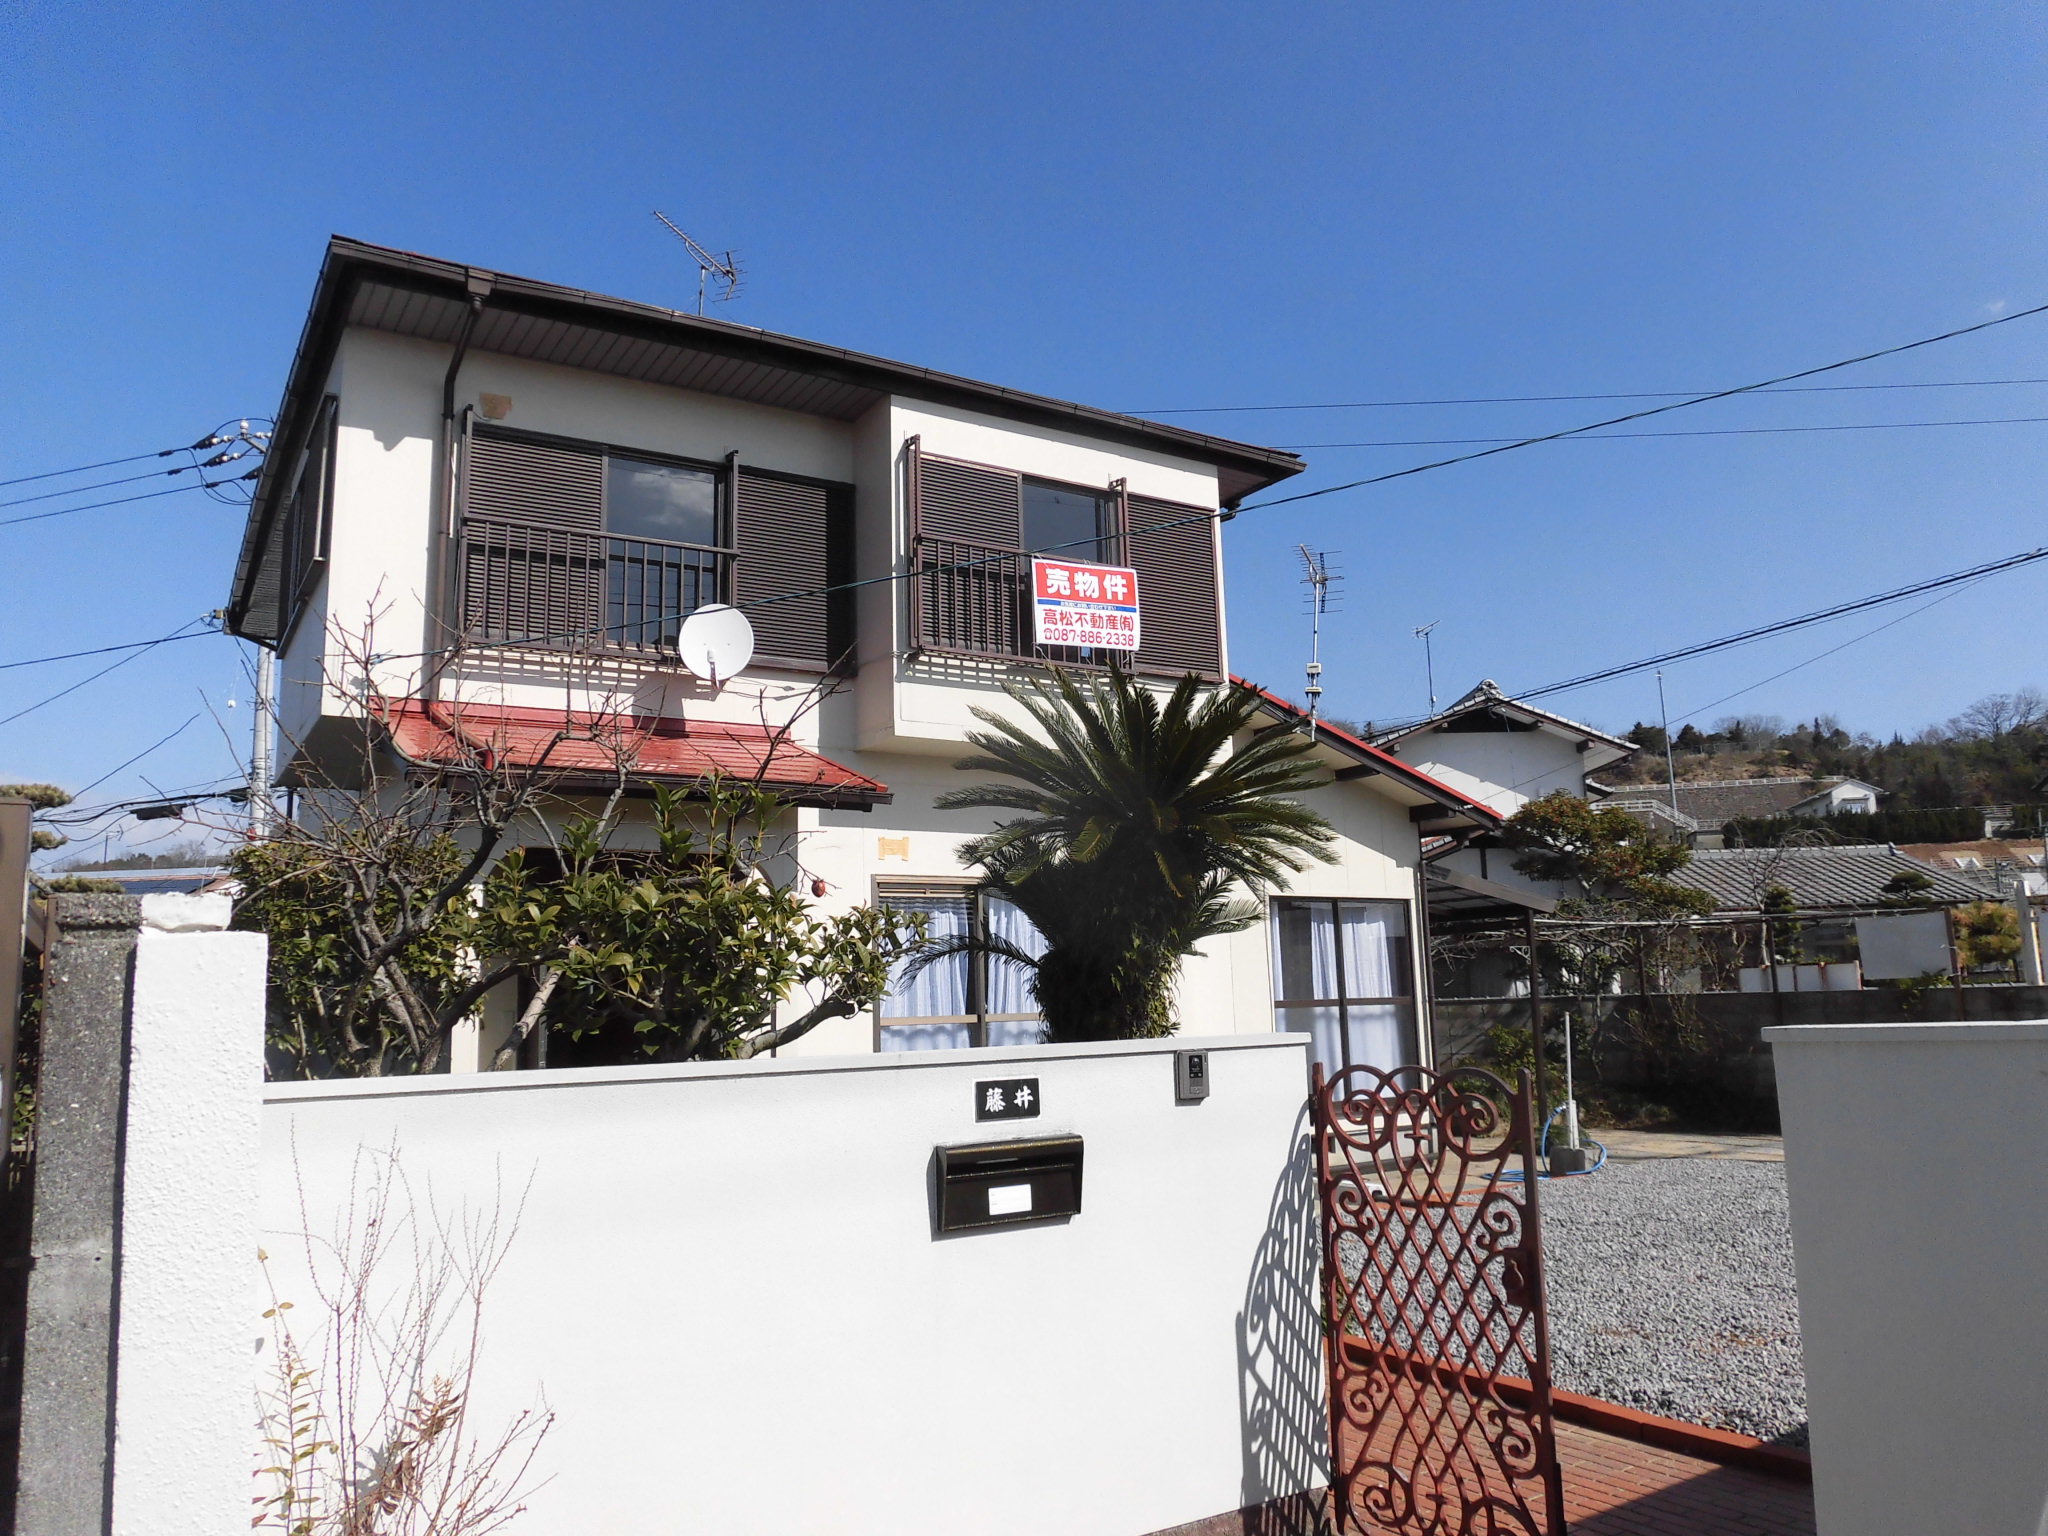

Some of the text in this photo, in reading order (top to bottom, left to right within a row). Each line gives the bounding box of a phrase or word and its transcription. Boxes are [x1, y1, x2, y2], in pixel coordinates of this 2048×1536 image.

[1045, 568, 1128, 600] 売物件
[985, 1085, 1034, 1112] 藤井
